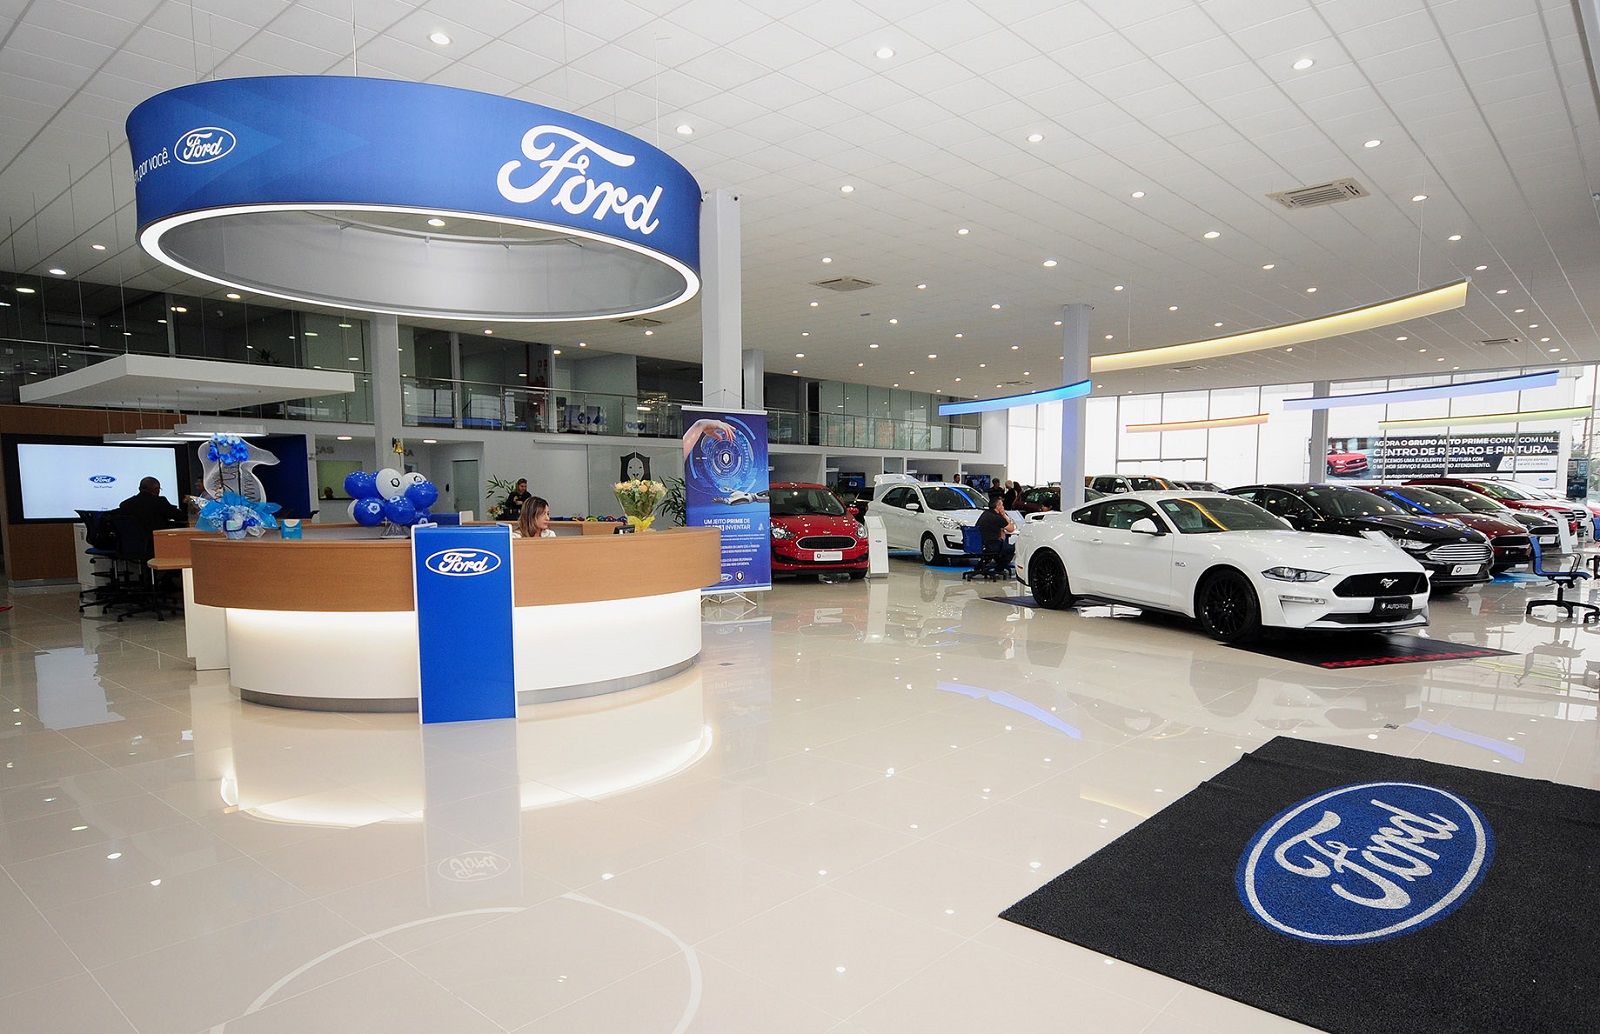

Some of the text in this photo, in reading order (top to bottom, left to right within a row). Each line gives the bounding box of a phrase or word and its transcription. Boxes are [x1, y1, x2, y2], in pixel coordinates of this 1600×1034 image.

[148, 147, 171, 171] você.
[183, 132, 223, 160] Ford
[496, 124, 663, 235] Ford
[1373, 445, 1553, 457] CENTRO DE REPARO E PINTURA.
[438, 552, 489, 573] Ford
[1274, 799, 1459, 910] Ford
